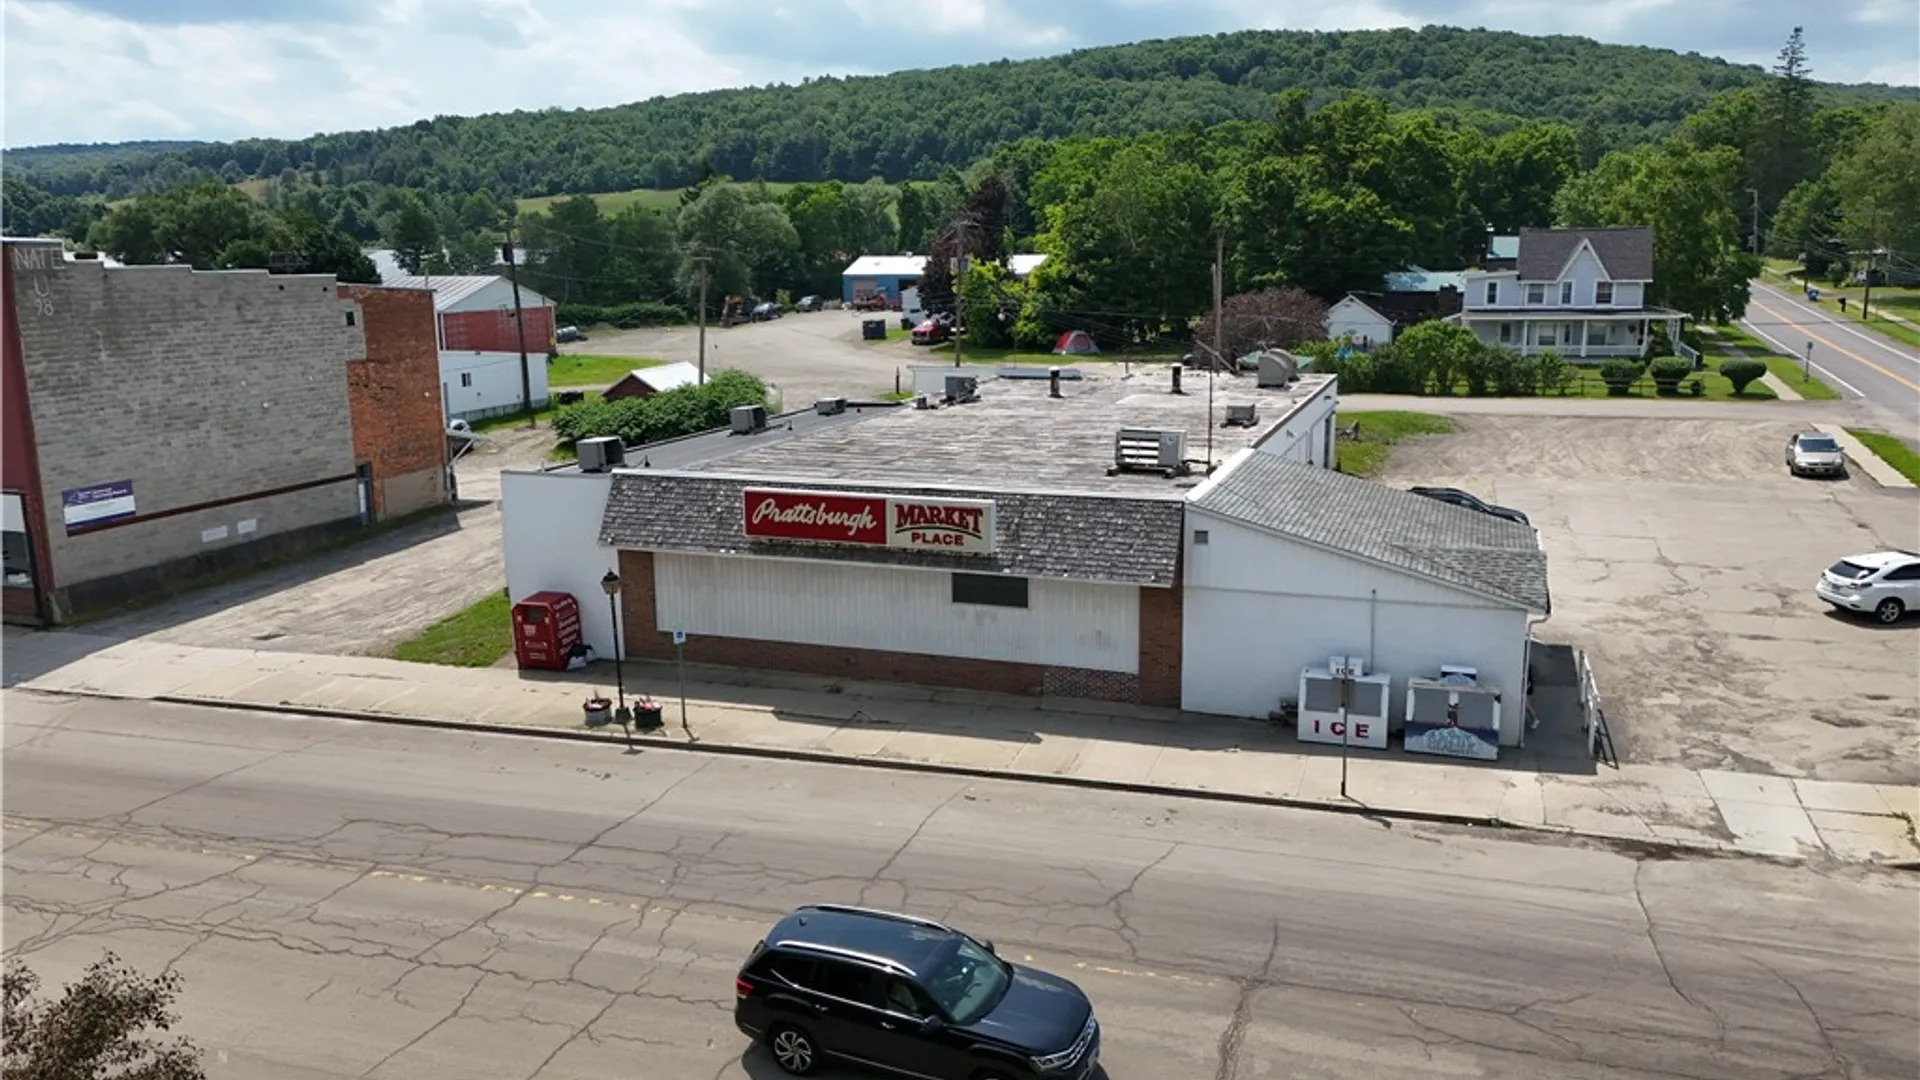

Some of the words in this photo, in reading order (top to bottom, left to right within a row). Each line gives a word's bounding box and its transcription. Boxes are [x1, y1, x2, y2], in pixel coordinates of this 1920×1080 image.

[13, 248, 66, 269] NATE
[752, 498, 877, 536] Prattsburgh
[895, 503, 983, 533] MARKET
[911, 532, 964, 546] PLACE
[1313, 720, 1369, 738] ICE
